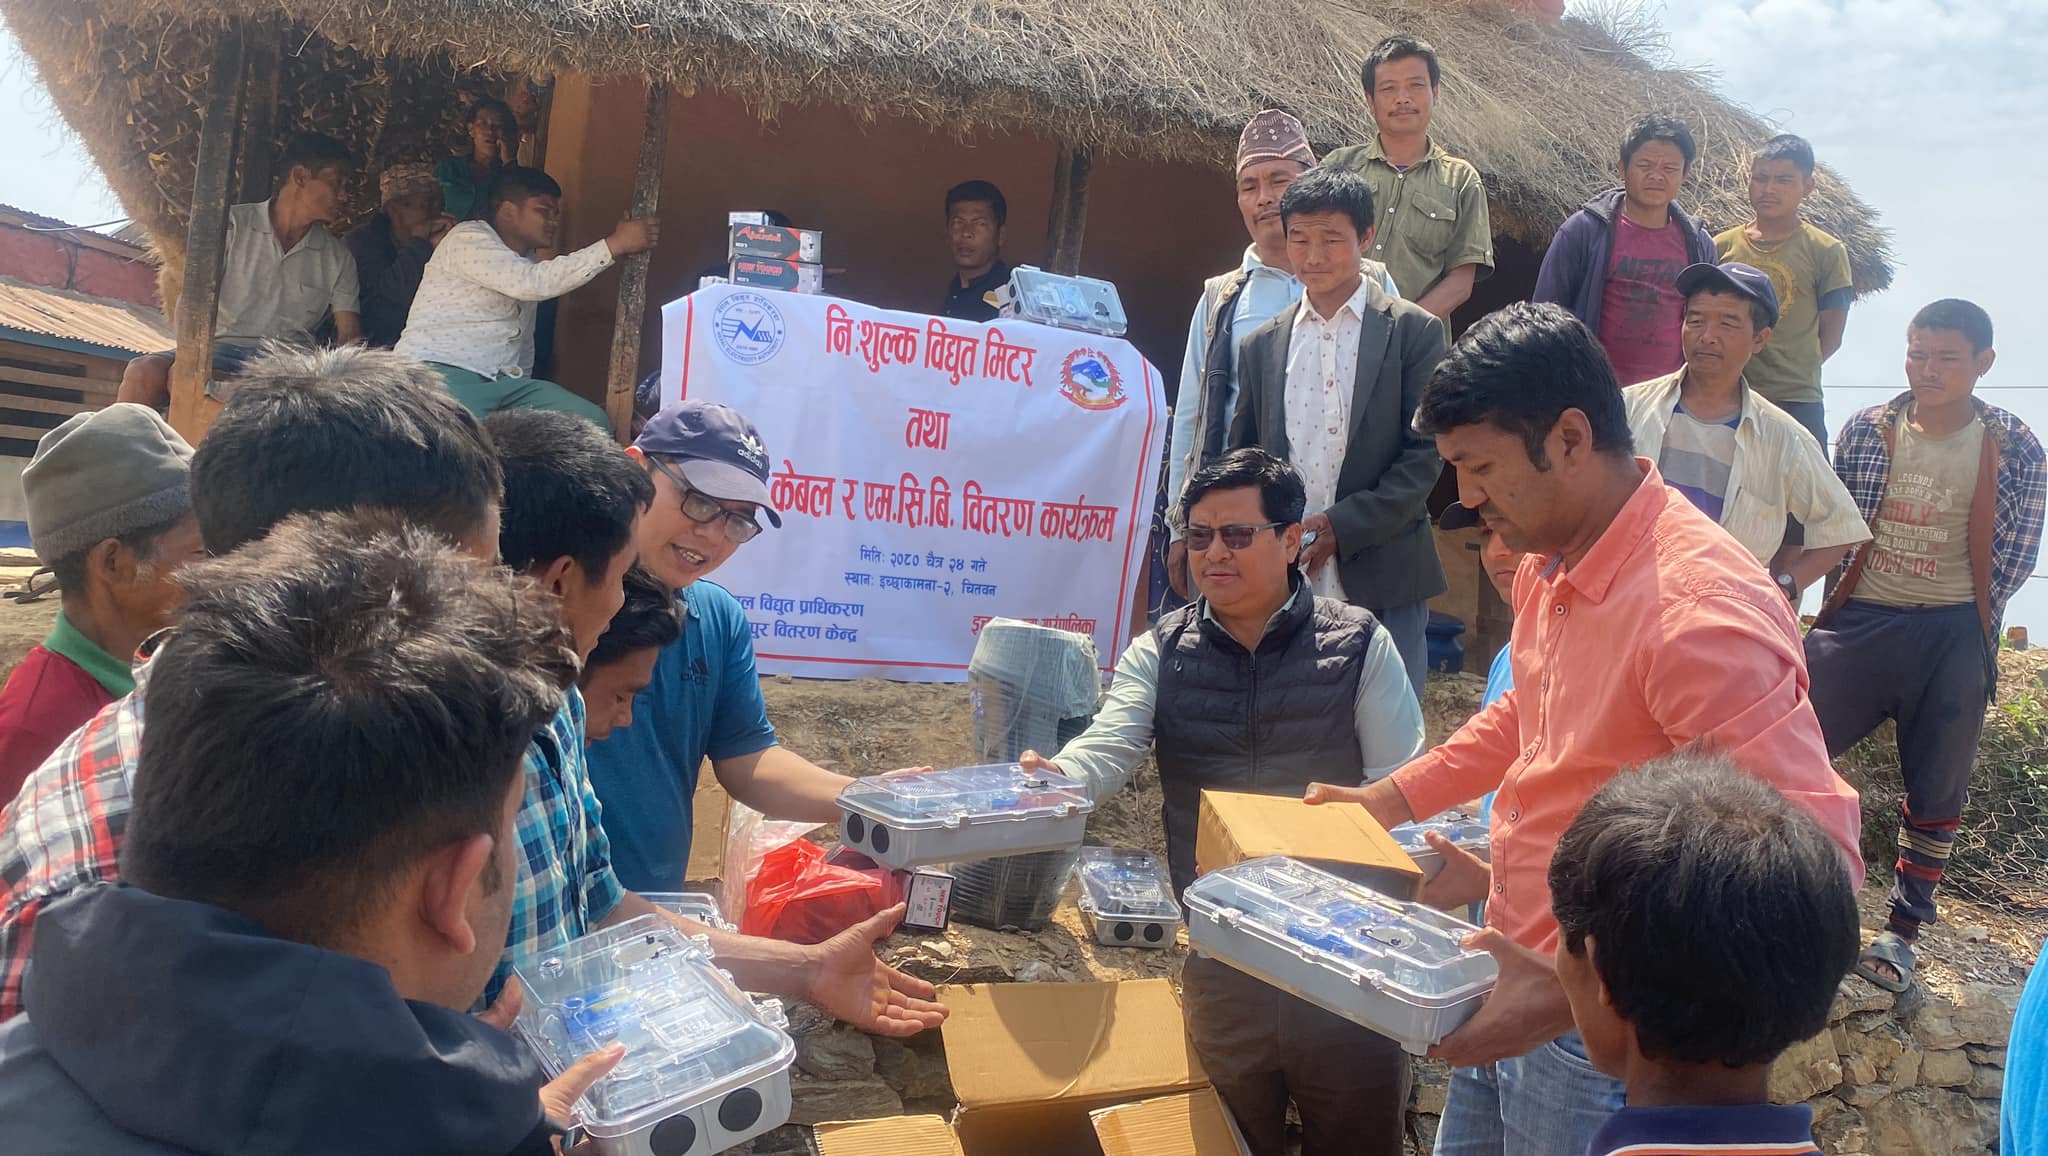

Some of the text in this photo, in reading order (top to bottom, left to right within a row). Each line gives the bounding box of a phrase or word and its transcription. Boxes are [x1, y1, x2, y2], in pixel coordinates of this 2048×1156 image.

[924, 318, 980, 386] विद्युत
[982, 327, 1037, 387] मिटर
[905, 408, 951, 450] तथा
[1897, 473, 1934, 487] LEGENDS
[770, 459, 836, 518] केबल
[842, 479, 859, 521] र
[962, 480, 1035, 538] वितरण
[1039, 494, 1119, 543] कार्यक्रम
[1885, 501, 1936, 526] JULY
[1892, 537, 1915, 551] BORN
[1917, 541, 1929, 553] IN
[1914, 528, 1949, 541] LEGENDS
[890, 552, 919, 568] २०८०
[925, 550, 944, 569] चैत्र
[949, 558, 965, 573] २४
[970, 557, 987, 573] गते
[961, 578, 997, 597] चितवन
[760, 593, 795, 615] विद्युत
[799, 597, 864, 617] प्राधिकरण
[774, 620, 821, 640] वितरण
[825, 624, 858, 643] केन्द्र
